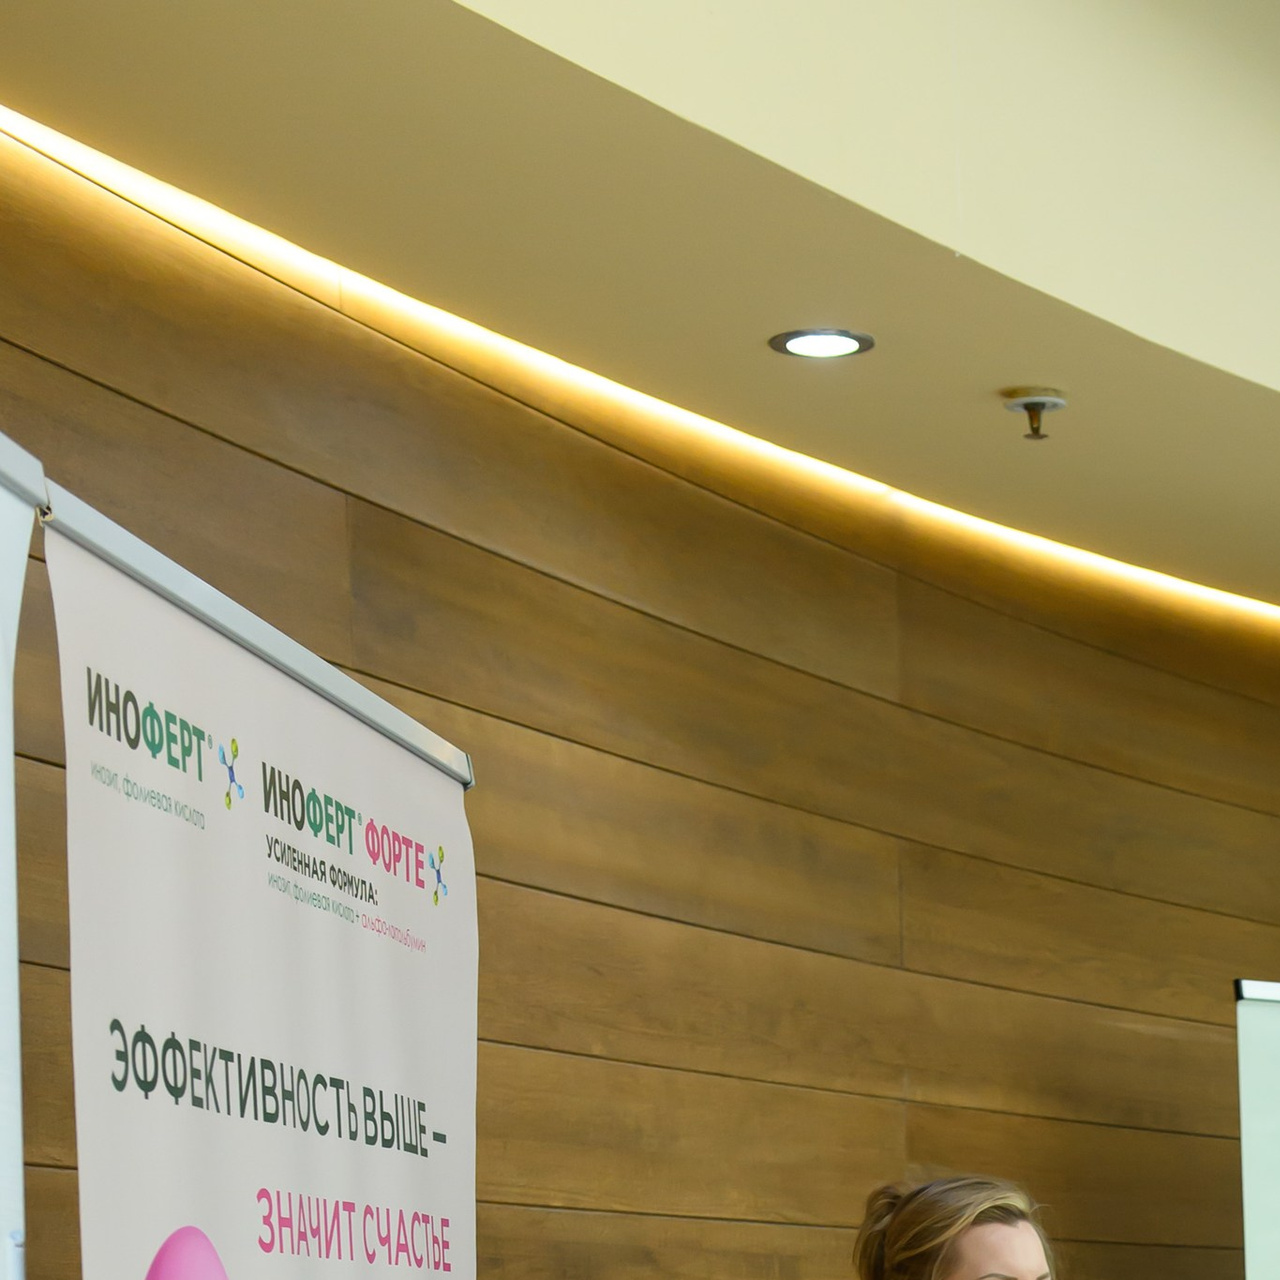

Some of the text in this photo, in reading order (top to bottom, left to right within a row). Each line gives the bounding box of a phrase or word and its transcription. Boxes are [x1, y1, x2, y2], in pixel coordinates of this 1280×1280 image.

[265, 834, 379, 905] УСИЛЕННАЯ ФОРМУЛА:
[365, 818, 425, 889] ФОРТЕ
[109, 1018, 359, 1141] ЭФФЕКТИВНОСТЬ
[362, 1086, 429, 1158] ВЫШЕ
[256, 1188, 452, 1272] ЗНАЧИТ СЧАСТЬЕ
